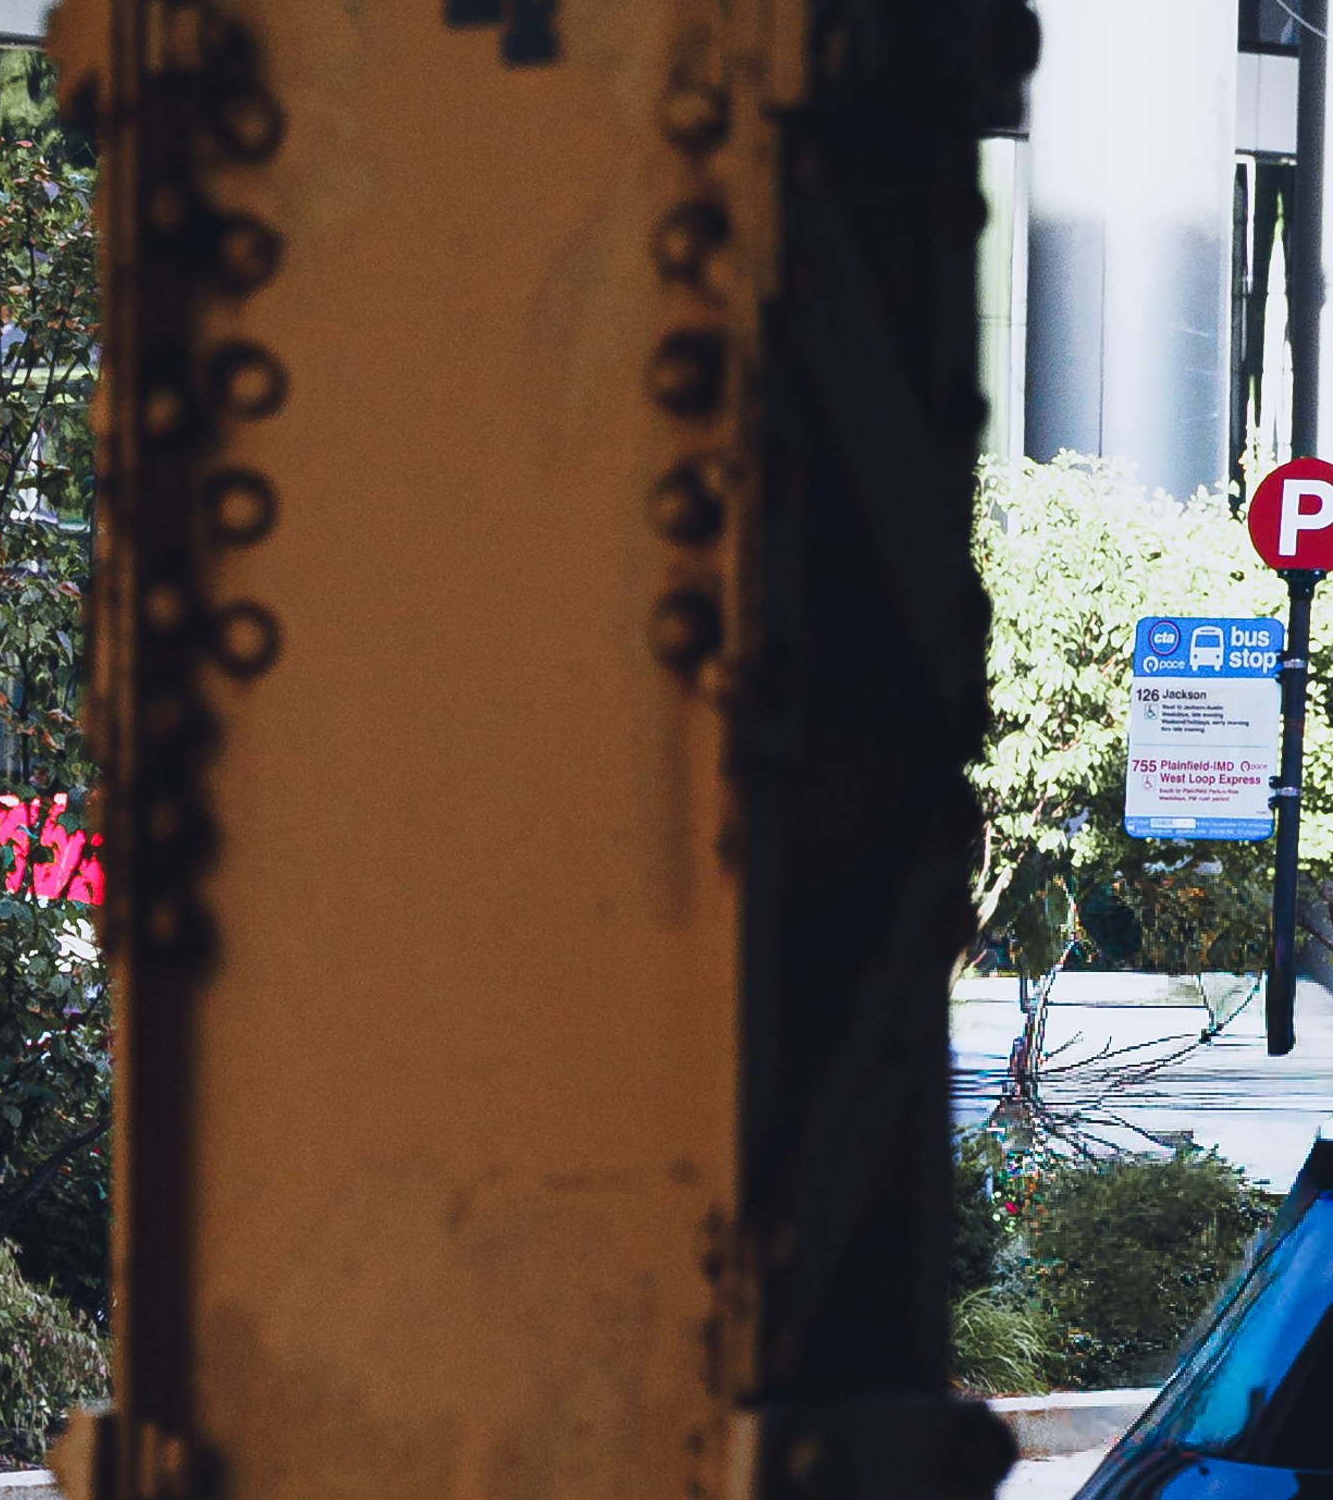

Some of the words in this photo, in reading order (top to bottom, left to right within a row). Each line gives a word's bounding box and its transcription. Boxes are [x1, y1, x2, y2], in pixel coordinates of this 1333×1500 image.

[1279, 478, 1333, 556] P
[1154, 631, 1176, 645] cta
[1231, 626, 1271, 648] bus
[1159, 659, 1186, 670] pace
[1229, 648, 1277, 674] stop
[1136, 688, 1160, 702] 126
[1162, 689, 1208, 700] Jackson
[1132, 760, 1157, 773] 755
[1160, 760, 1235, 771] Plainfield-IMD
[1160, 773, 1185, 784] West
[1188, 773, 1216, 786] Loop
[1219, 773, 1261, 787] Express
